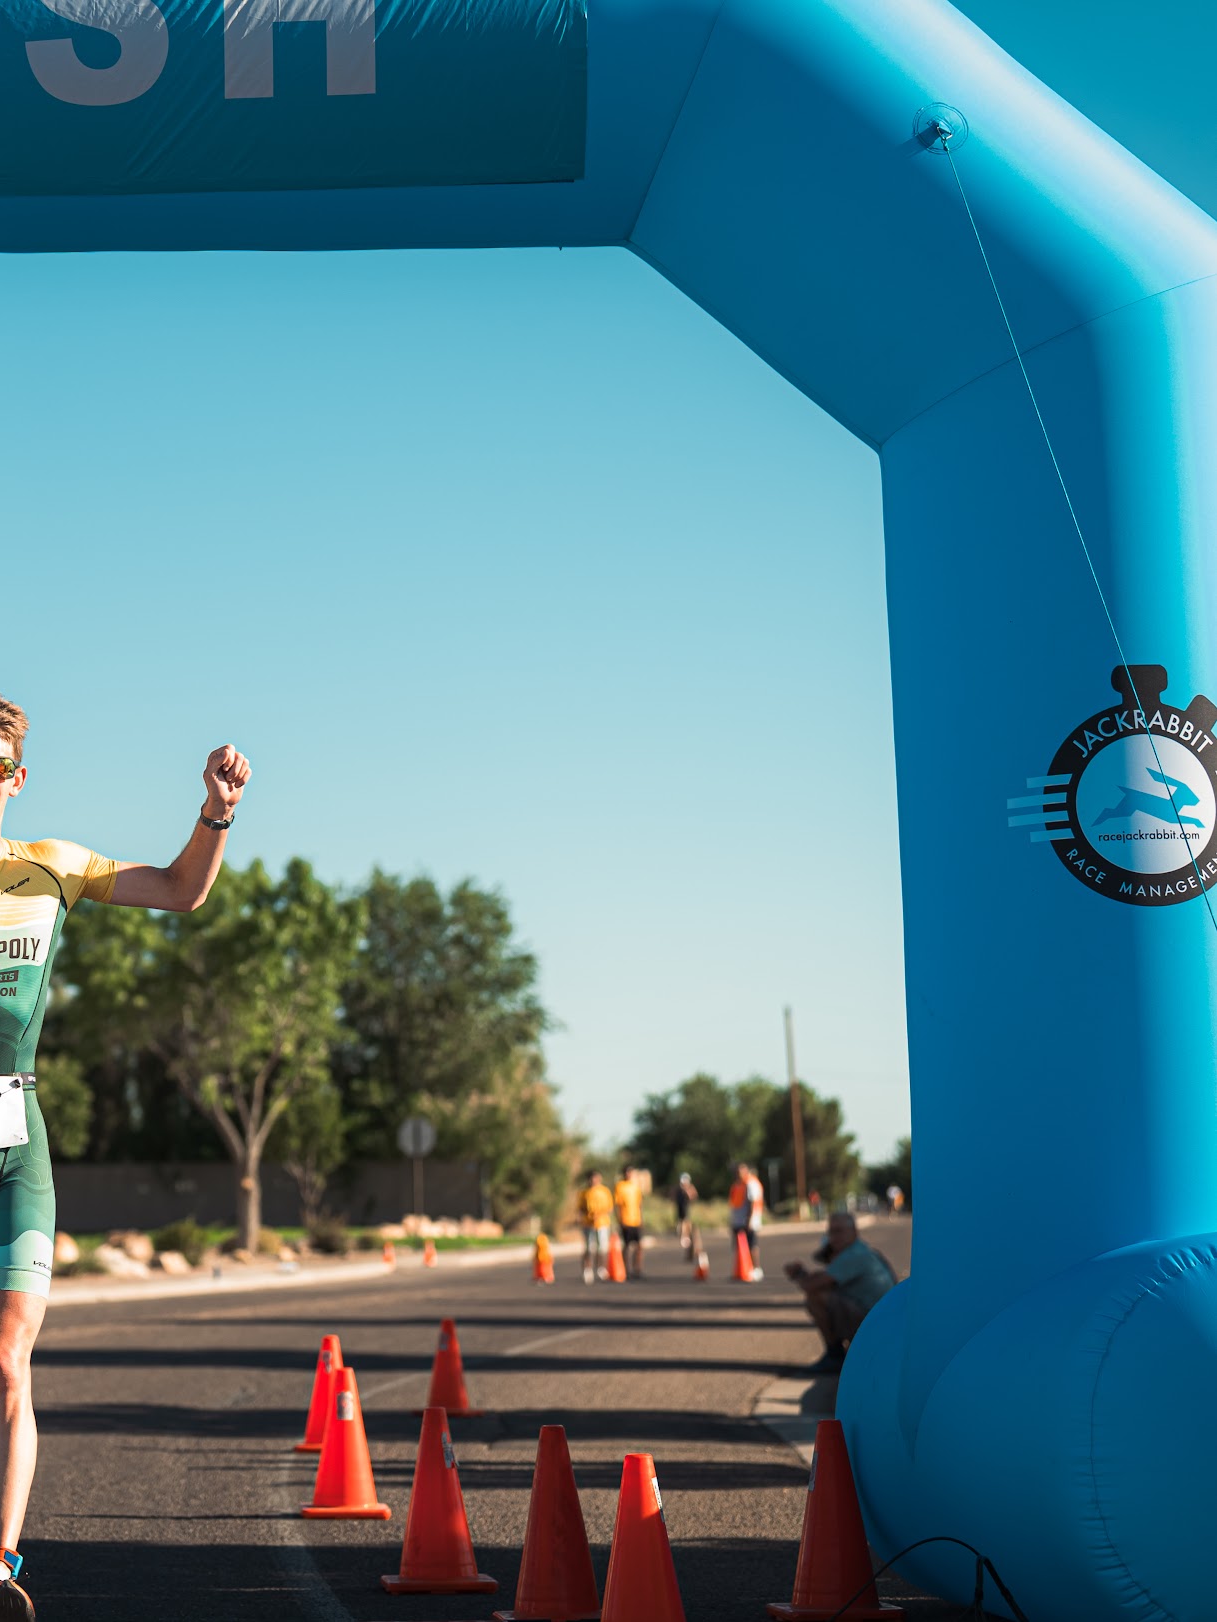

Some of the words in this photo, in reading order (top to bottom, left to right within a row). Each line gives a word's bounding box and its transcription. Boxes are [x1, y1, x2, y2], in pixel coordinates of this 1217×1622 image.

[1073, 709, 1214, 758] JACKRABBIT
[1098, 829, 1200, 843] racejackrabbit.com
[1066, 848, 1107, 884] RACE
